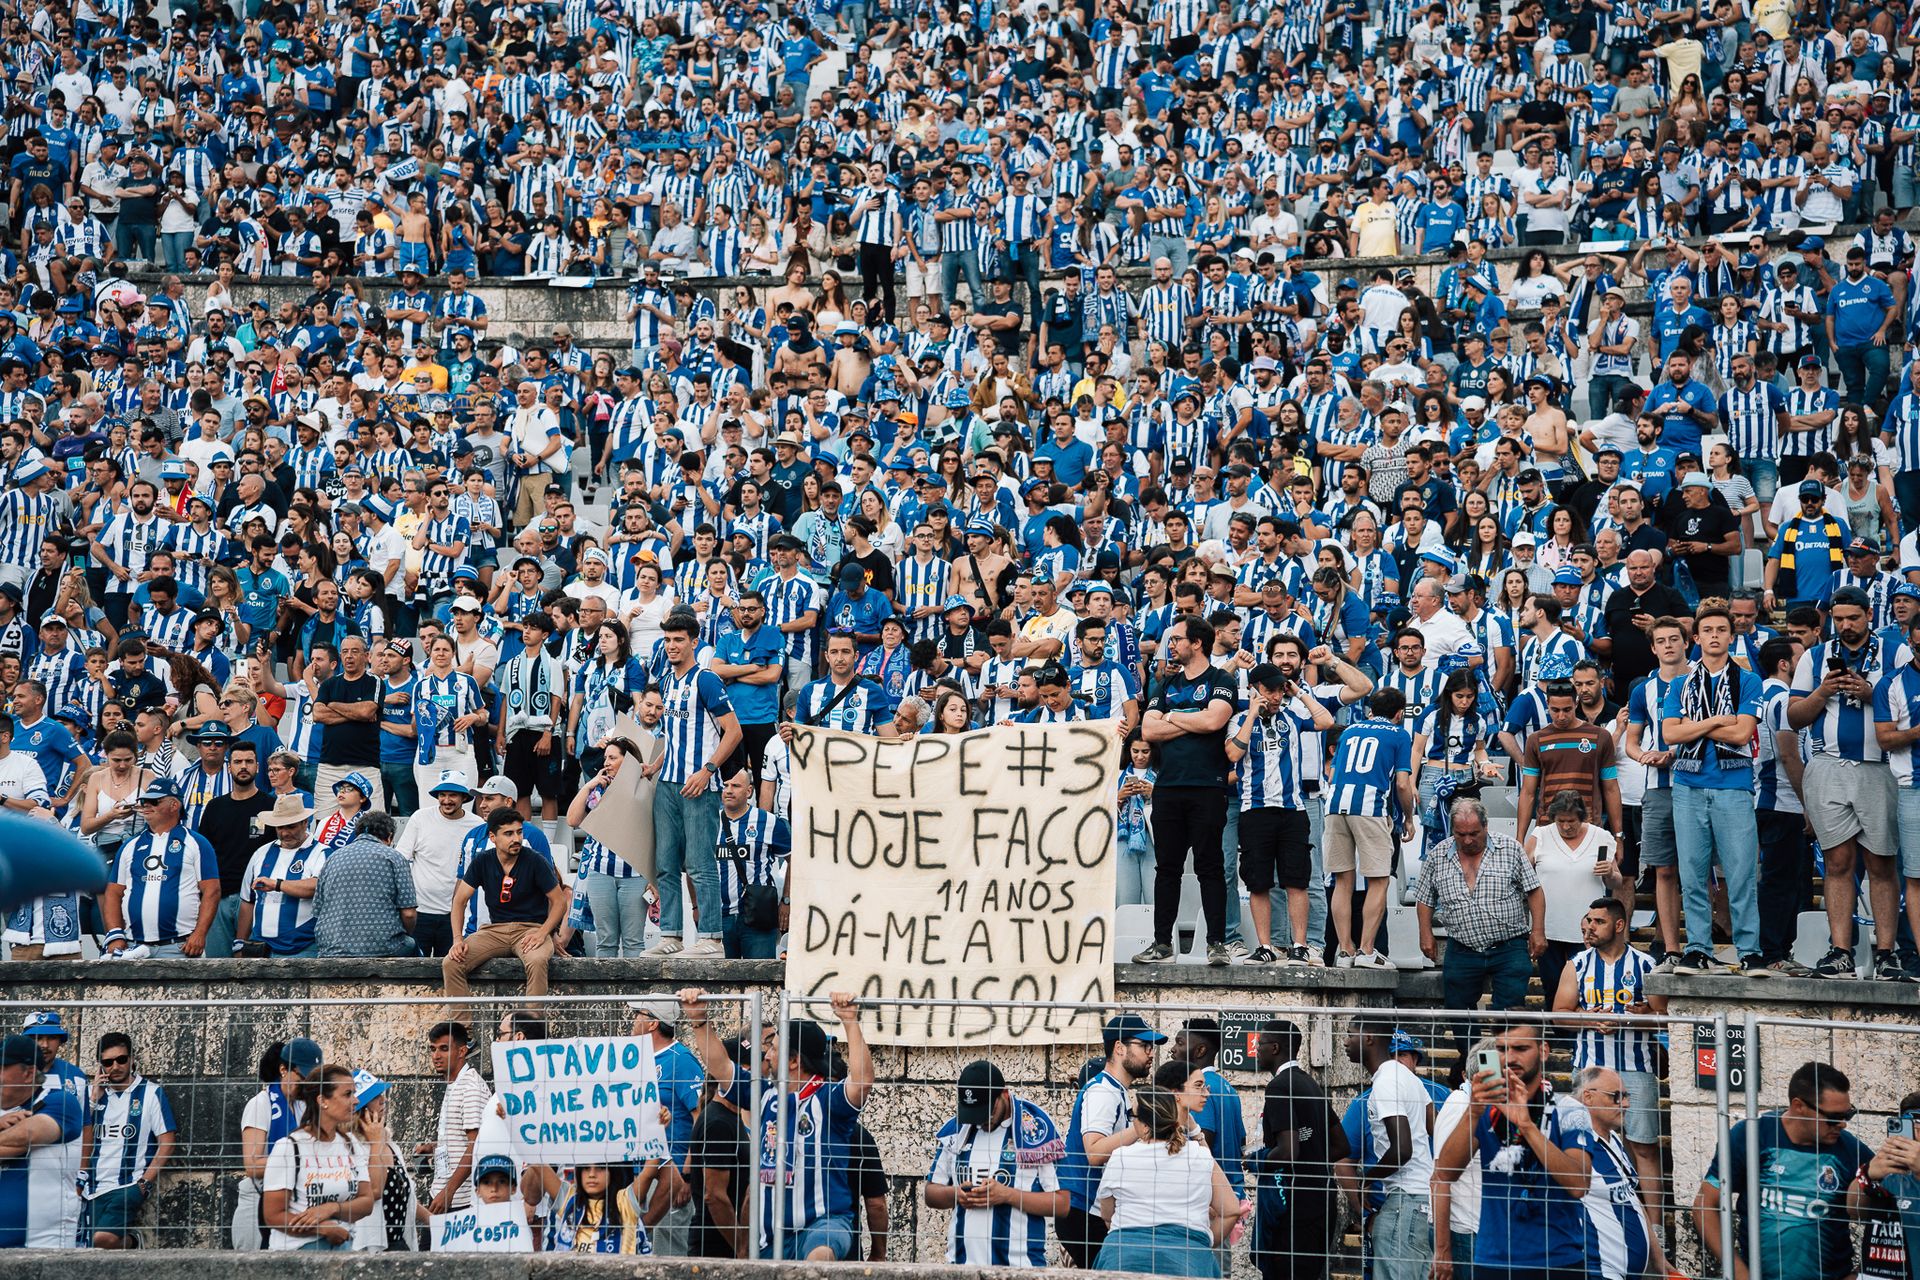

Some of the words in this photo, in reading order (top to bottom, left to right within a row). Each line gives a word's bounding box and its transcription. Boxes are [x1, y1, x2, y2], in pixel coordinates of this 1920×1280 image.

[823, 733, 991, 799] PEPE
[1005, 728, 1109, 796] #3
[1344, 735, 1380, 776] 10
[808, 806, 947, 870] HOJE
[972, 805, 1114, 875] FAÇO
[936, 878, 968, 913] 11
[981, 877, 1075, 914] ANOS
[805, 893, 946, 965] DÁ-ME
[1009, 916, 1106, 965] TUA
[804, 971, 1108, 1038] CAMISOLA
[1224, 1026, 1243, 1040] 27
[1223, 1049, 1244, 1066] 05
[519, 1117, 637, 1145] CAMISOLA
[473, 1219, 520, 1243] COSTA
